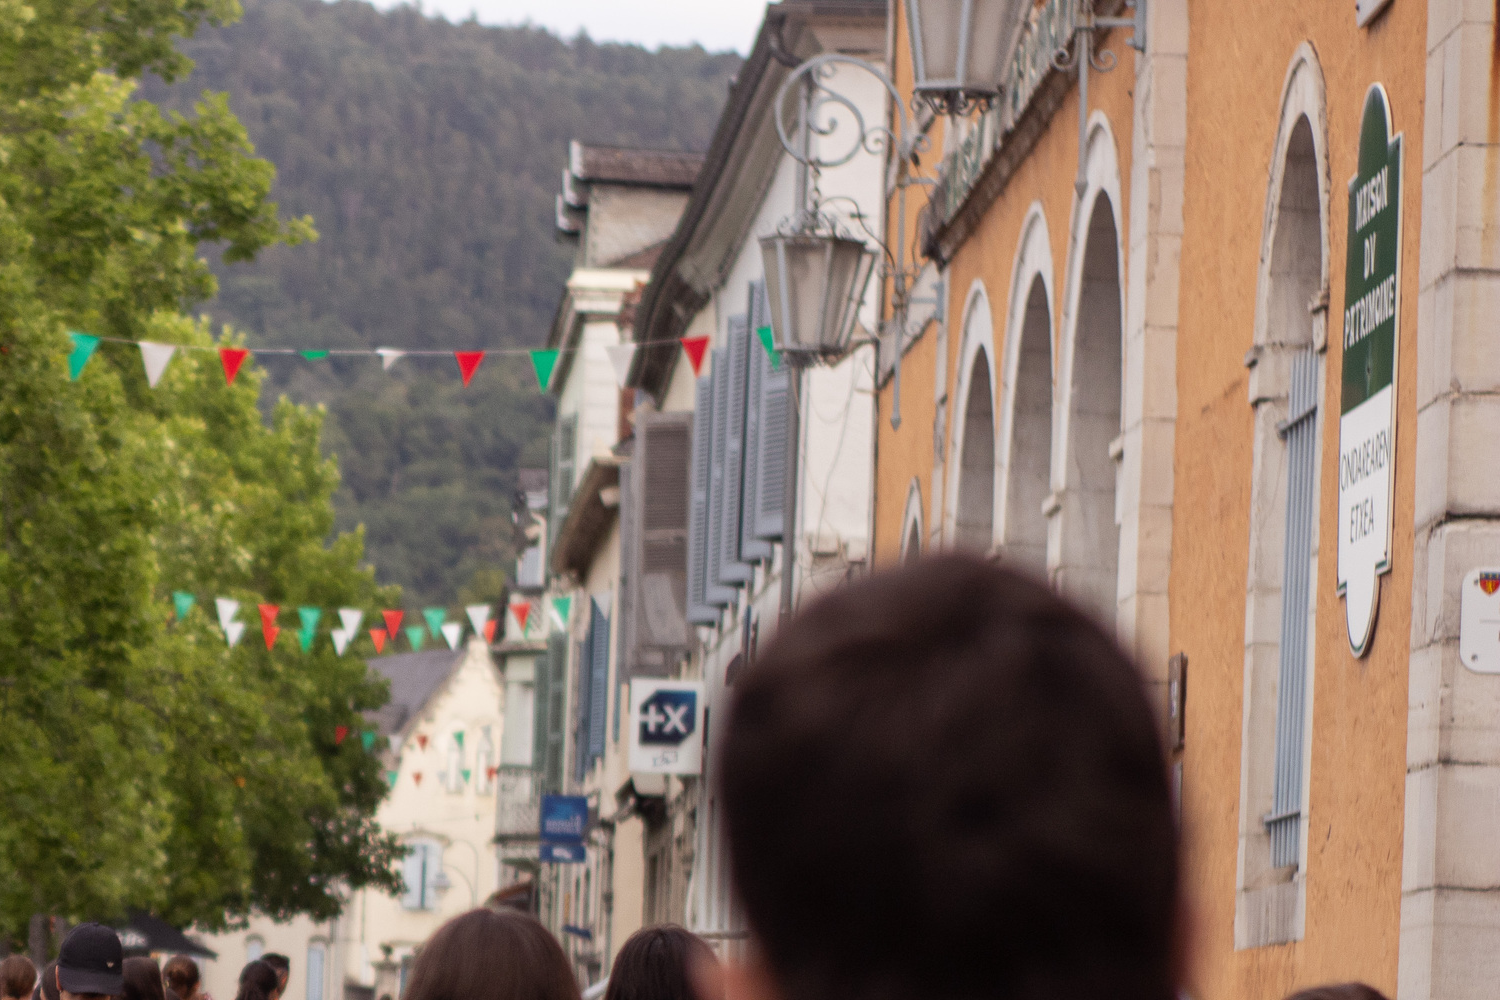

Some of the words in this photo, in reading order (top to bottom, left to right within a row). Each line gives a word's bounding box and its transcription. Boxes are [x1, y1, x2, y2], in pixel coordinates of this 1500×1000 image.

[1356, 165, 1388, 232] MAISON
[1344, 273, 1394, 350] PATRIMOINE
[1341, 429, 1389, 492] ONDAREAREN
[1350, 496, 1374, 543] ETXEA
